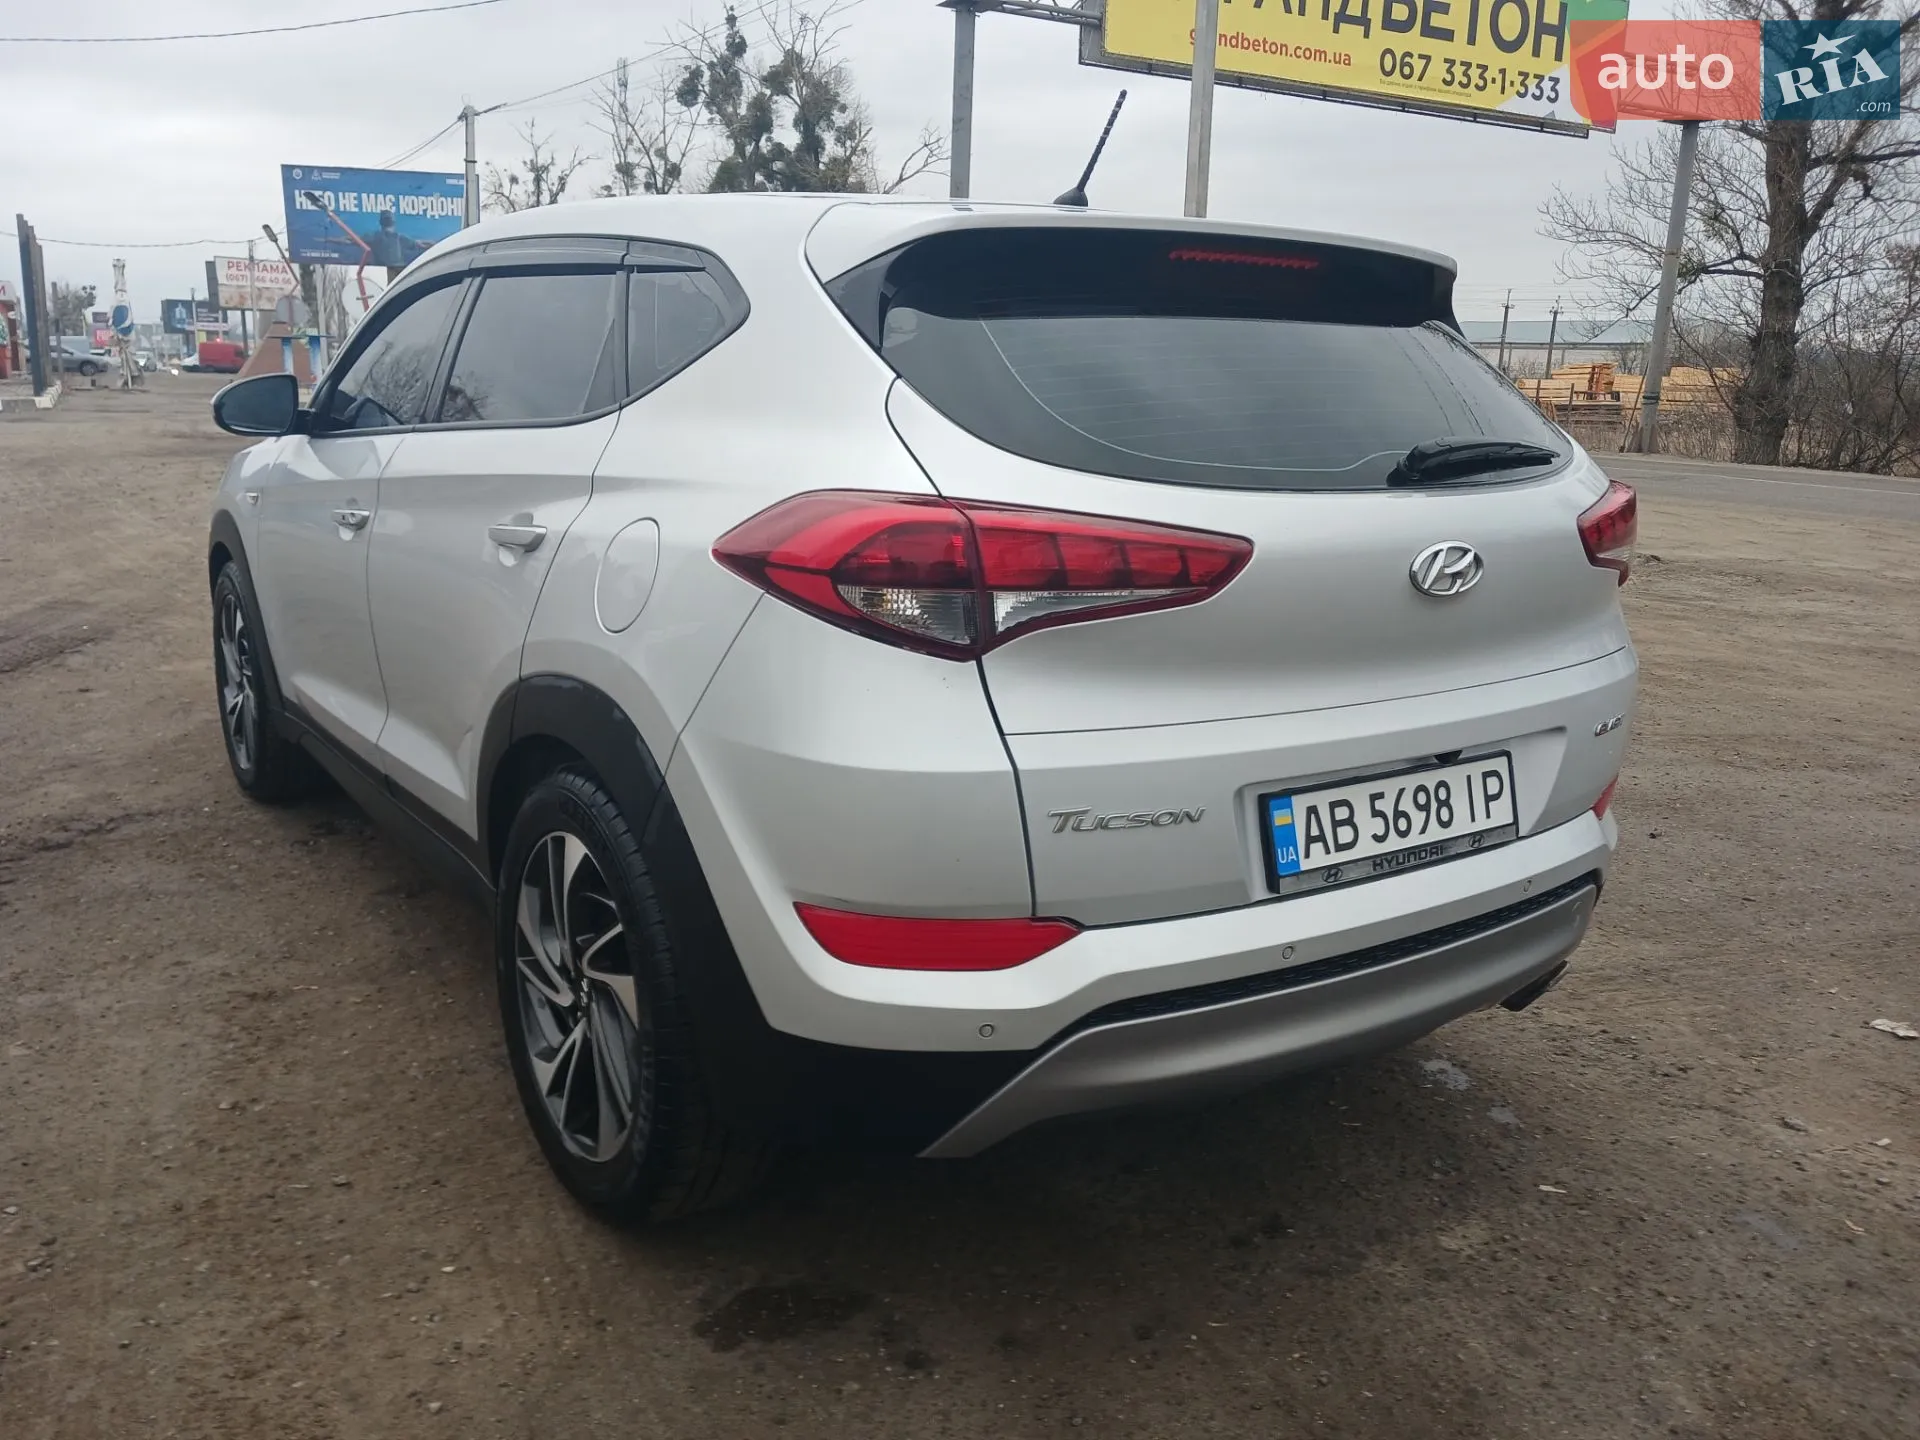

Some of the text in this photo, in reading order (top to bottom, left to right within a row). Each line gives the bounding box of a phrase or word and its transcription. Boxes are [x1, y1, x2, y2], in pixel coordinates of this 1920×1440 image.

[1190, 28, 1352, 66] gndbeton.com.ua
[1380, 47, 1432, 82] 067
[339, 191, 359, 213] НЕ
[362, 192, 395, 214] МАЄ
[399, 195, 462, 219] КОРДОНІ
[1047, 805, 1207, 834] TUCSON
[1304, 769, 1504, 859] AB 5698 IP
[1278, 848, 1298, 864] UA
[1372, 845, 1444, 872] HYUNDAI
